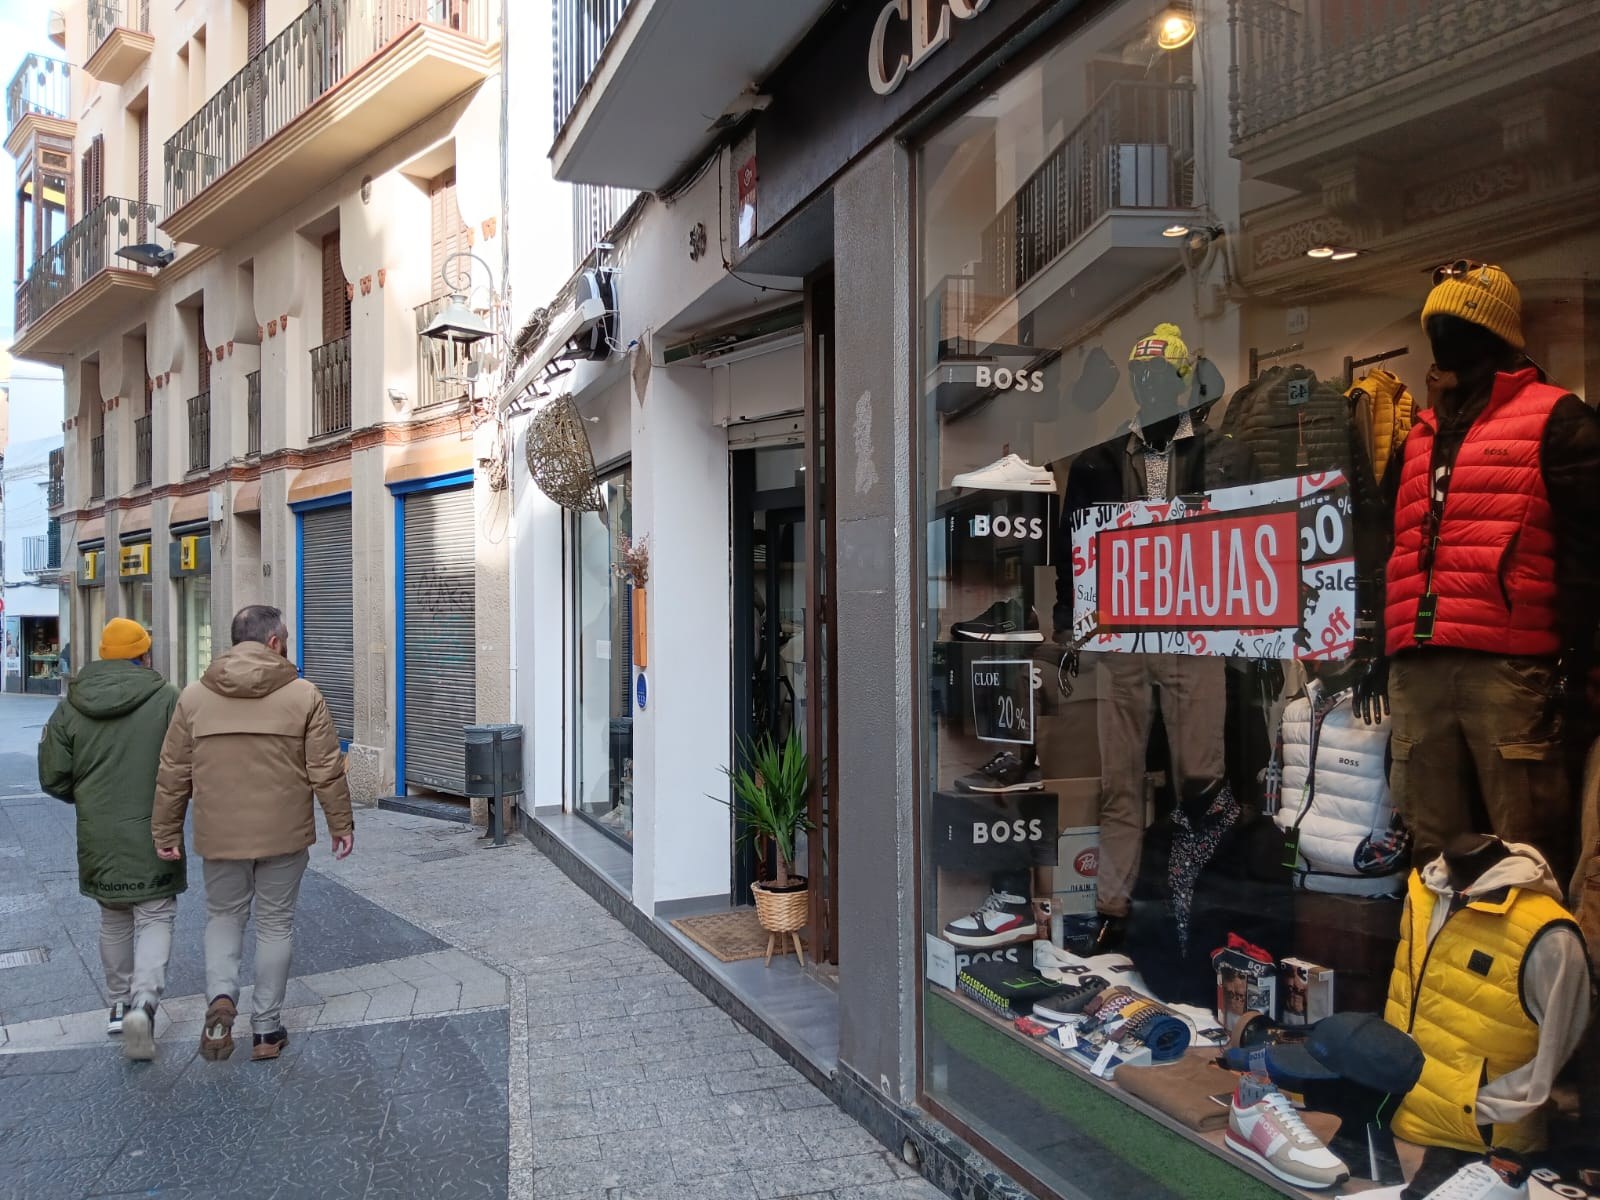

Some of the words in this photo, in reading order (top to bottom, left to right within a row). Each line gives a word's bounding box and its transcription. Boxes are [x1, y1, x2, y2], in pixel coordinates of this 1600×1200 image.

[868, 0, 991, 95] CL
[976, 365, 1044, 393] BOSS
[974, 514, 1043, 540] BOSS
[1111, 524, 1280, 617] REBAJAS
[1315, 569, 1357, 591] Sale
[1321, 606, 1351, 648] off
[1253, 635, 1286, 659] Sale
[974, 672, 1000, 686] CLOE
[1339, 757, 1360, 767] BOSS
[972, 818, 1043, 844] BOSS
[1248, 960, 1265, 973] BOS
